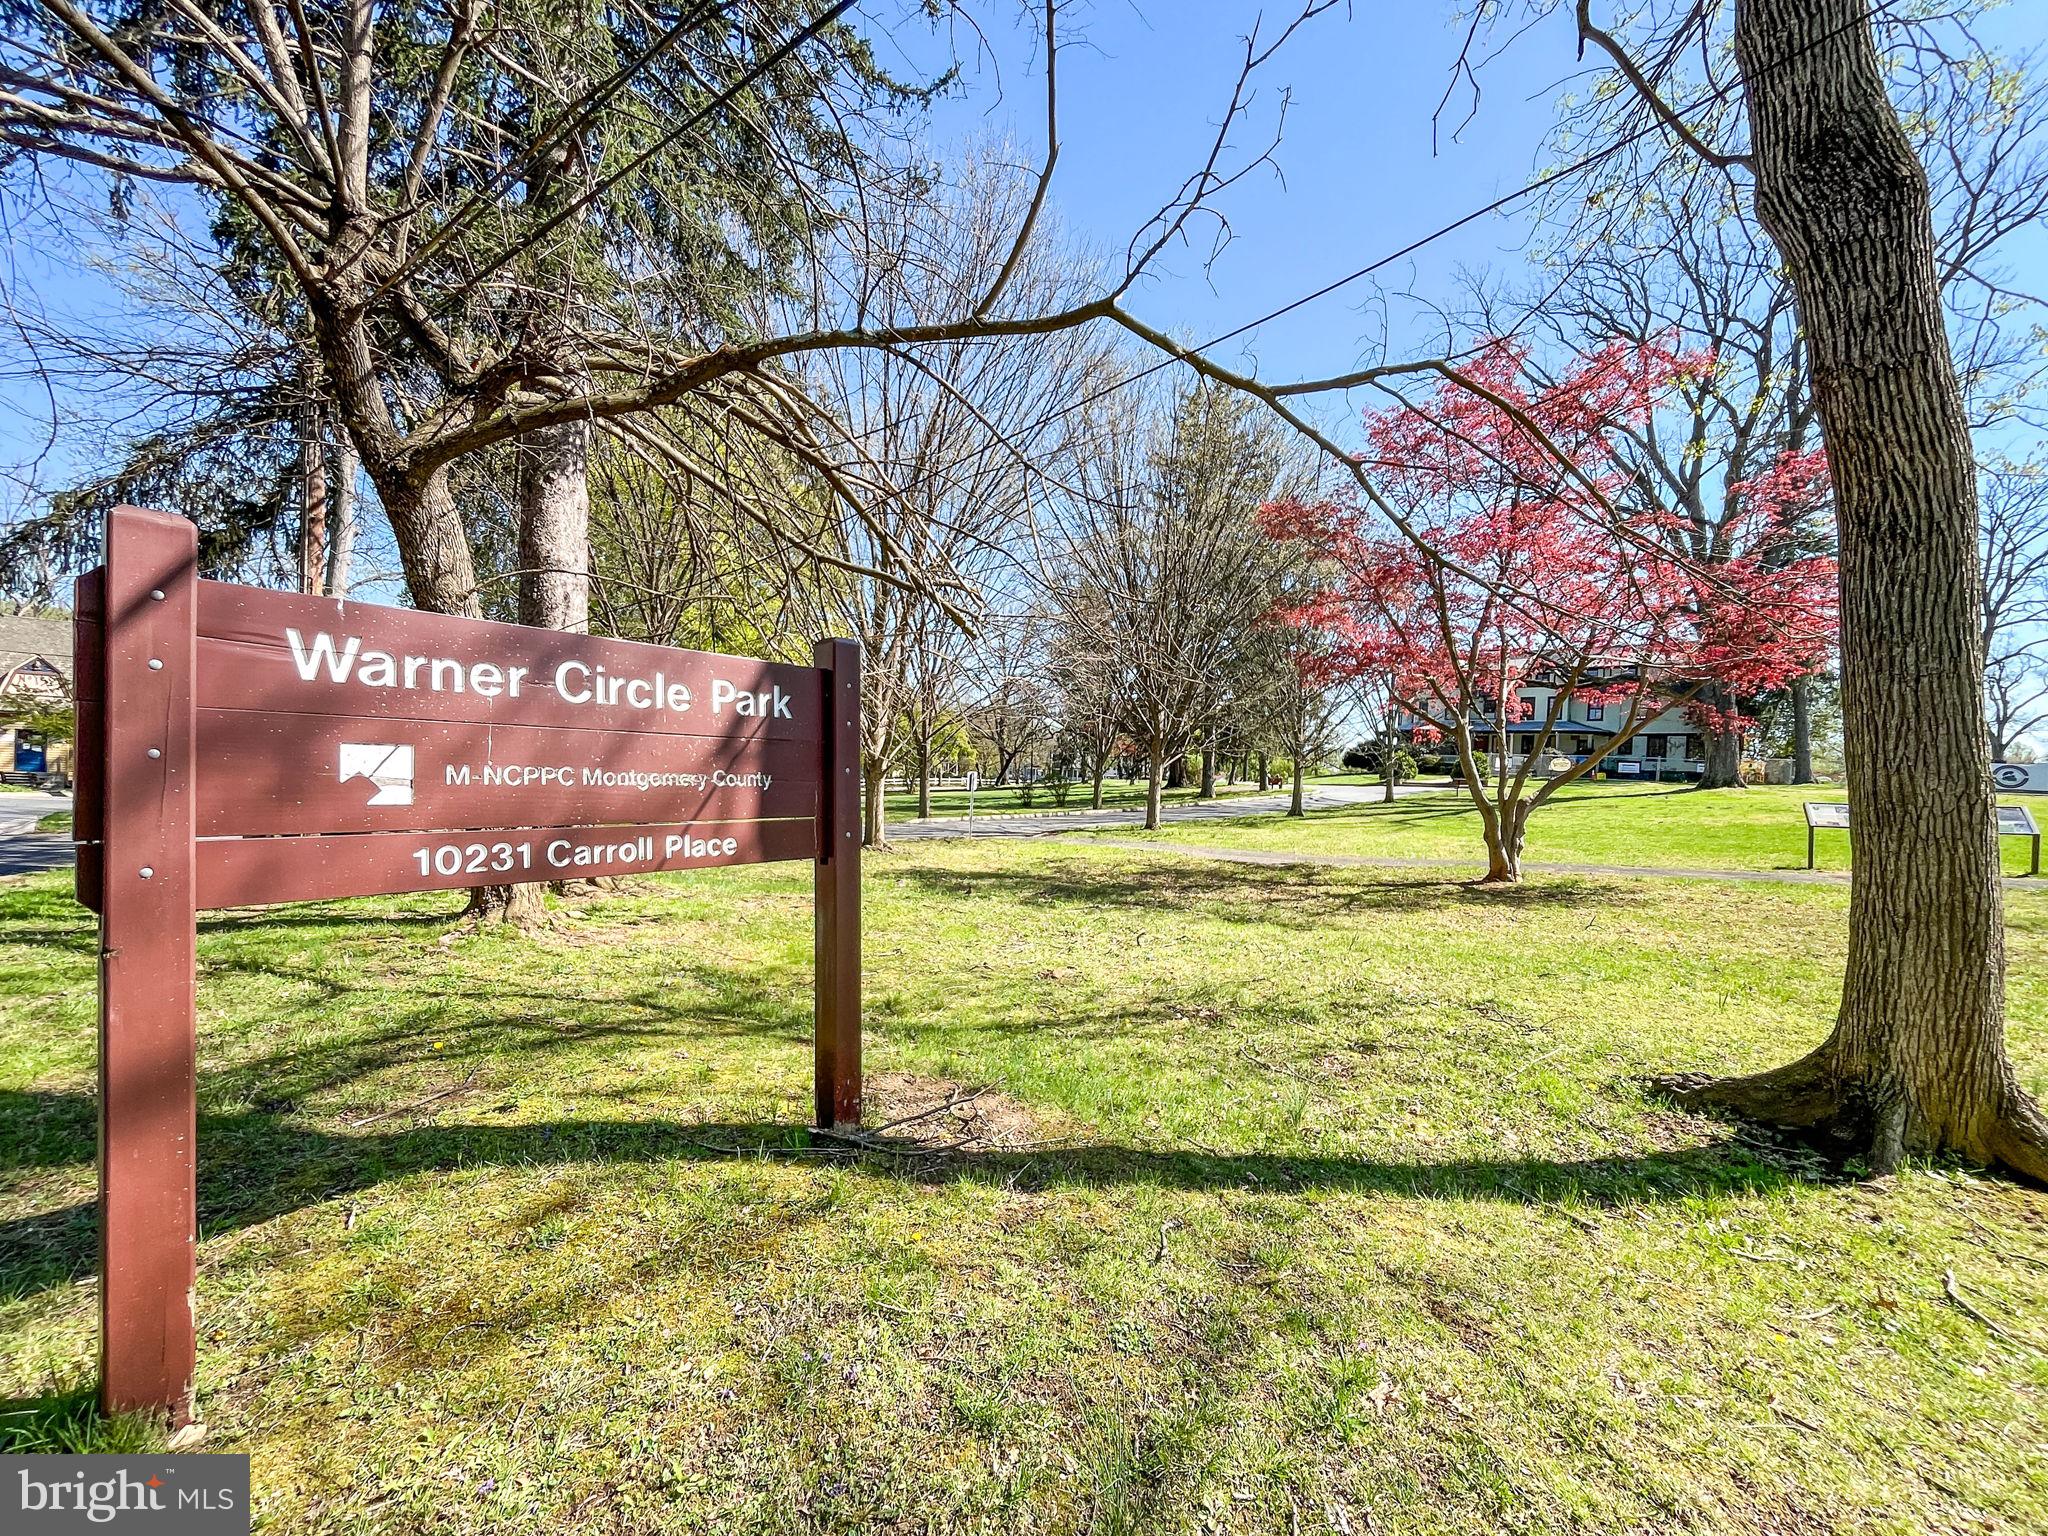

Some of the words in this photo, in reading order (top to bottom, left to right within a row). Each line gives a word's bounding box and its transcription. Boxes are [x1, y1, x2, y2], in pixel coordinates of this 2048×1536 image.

[285, 627, 529, 698] Warner
[555, 660, 693, 712] Circle
[712, 679, 793, 720] Park
[445, 764, 576, 787] M-NCPPC
[582, 767, 706, 791] Montgomery
[712, 769, 772, 791] County
[413, 842, 532, 877] 10231
[547, 838, 653, 868] Carroll
[665, 834, 738, 859] Place
